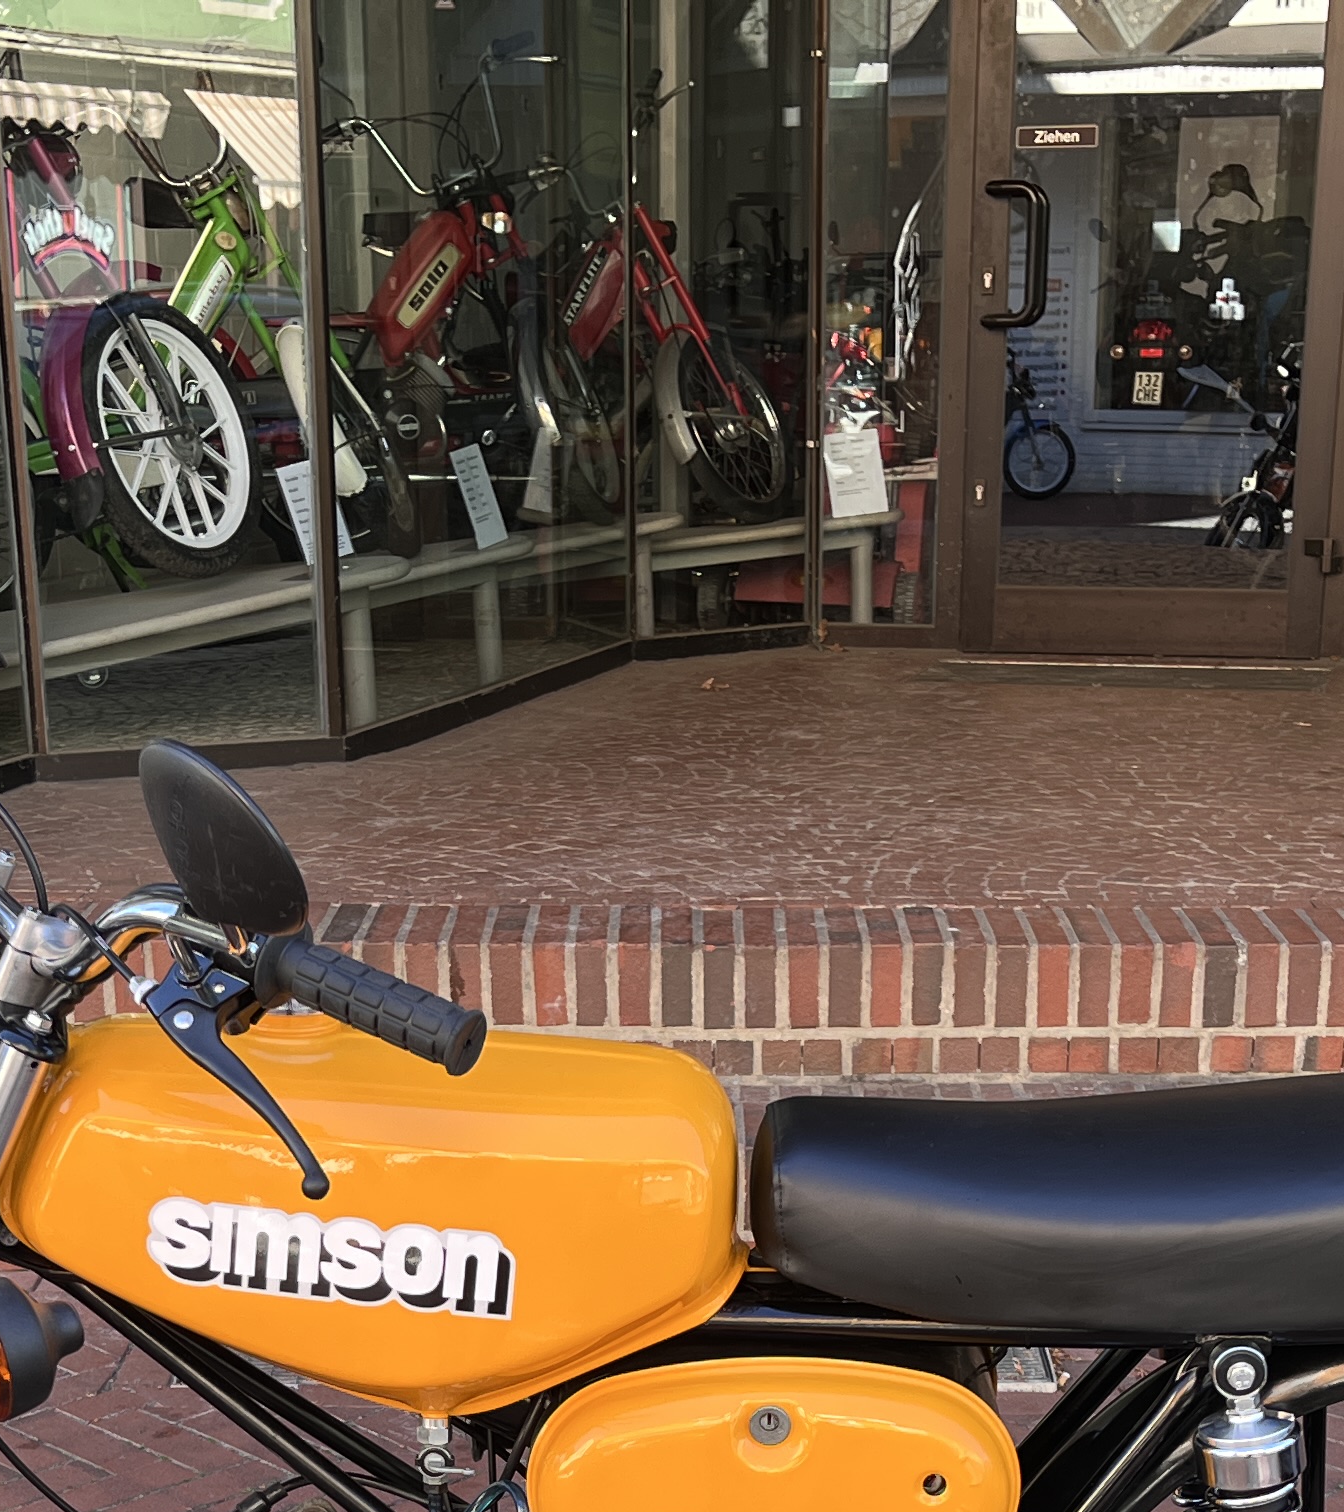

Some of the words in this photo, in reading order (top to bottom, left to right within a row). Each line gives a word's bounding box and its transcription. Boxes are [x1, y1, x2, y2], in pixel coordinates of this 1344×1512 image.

[1033, 130, 1080, 143] Ziehen
[1137, 374, 1160, 388] 132
[1135, 390, 1159, 403] CHE
